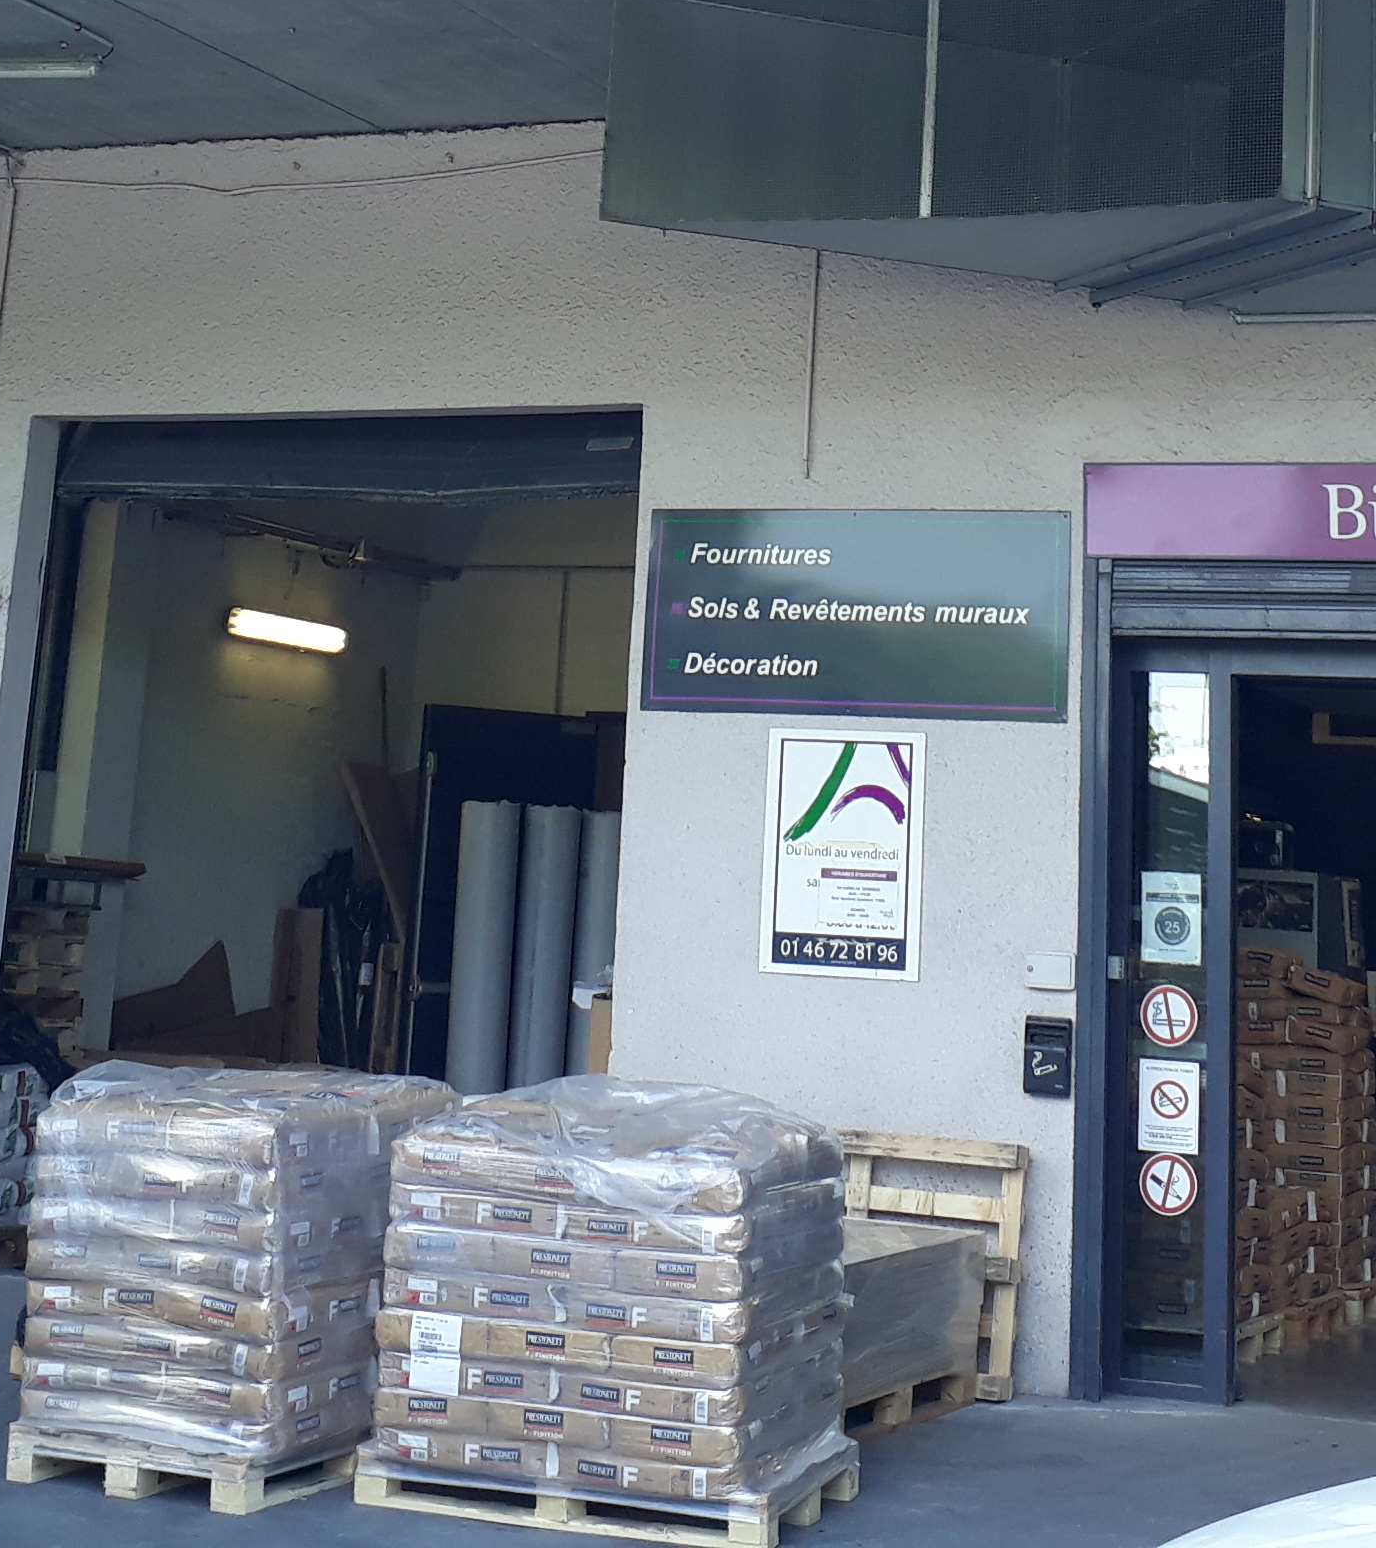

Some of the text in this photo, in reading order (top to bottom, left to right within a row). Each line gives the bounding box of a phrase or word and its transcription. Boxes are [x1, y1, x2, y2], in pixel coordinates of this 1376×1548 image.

[690, 542, 832, 566] Fournitures
[687, 597, 1030, 625] Sols & Revêtements muraux
[683, 652, 820, 677] Décoration
[785, 843, 900, 861] Du lundi au vendredi
[1164, 921, 1181, 935] 25
[780, 939, 898, 963] 01 46 72 81 96
